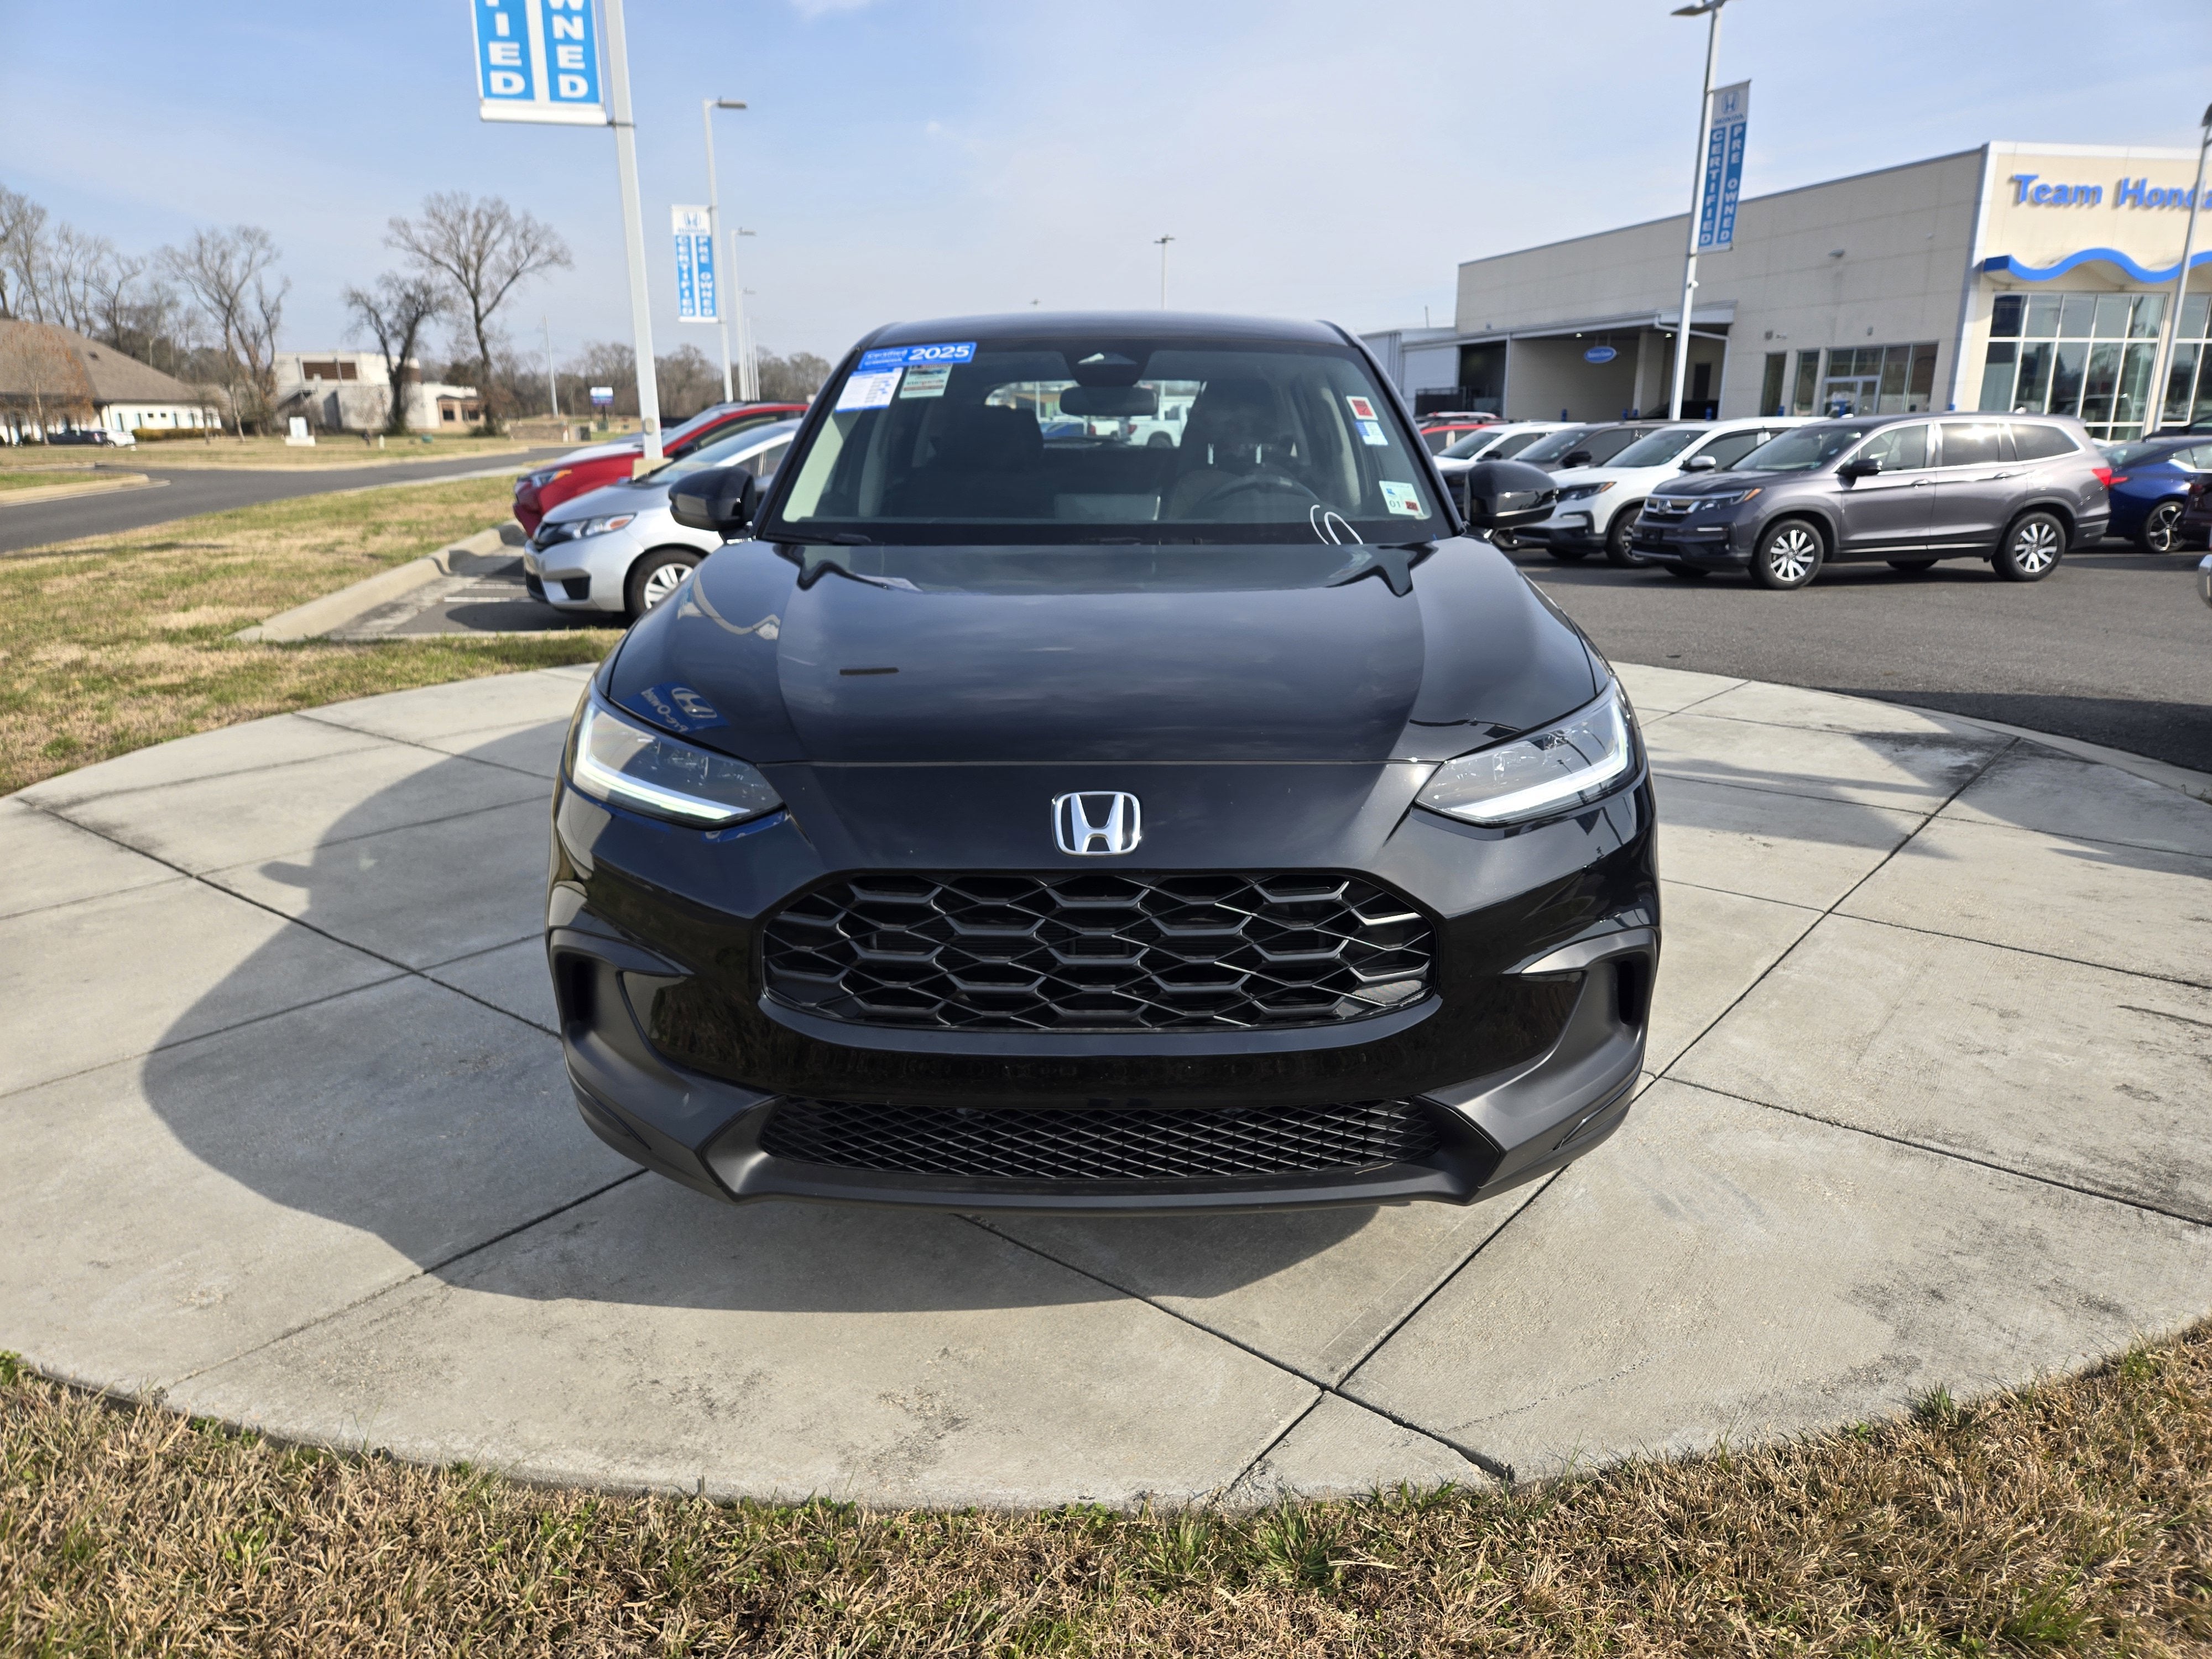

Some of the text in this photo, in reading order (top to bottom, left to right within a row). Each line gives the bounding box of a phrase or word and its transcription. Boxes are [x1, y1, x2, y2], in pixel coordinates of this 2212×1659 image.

[486, 0, 525, 95] IED
[1700, 129, 1723, 244] CERTIFIED
[1720, 125, 1743, 241] PRE OWNED
[2014, 174, 2103, 204] Team
[909, 345, 971, 361] 2025
